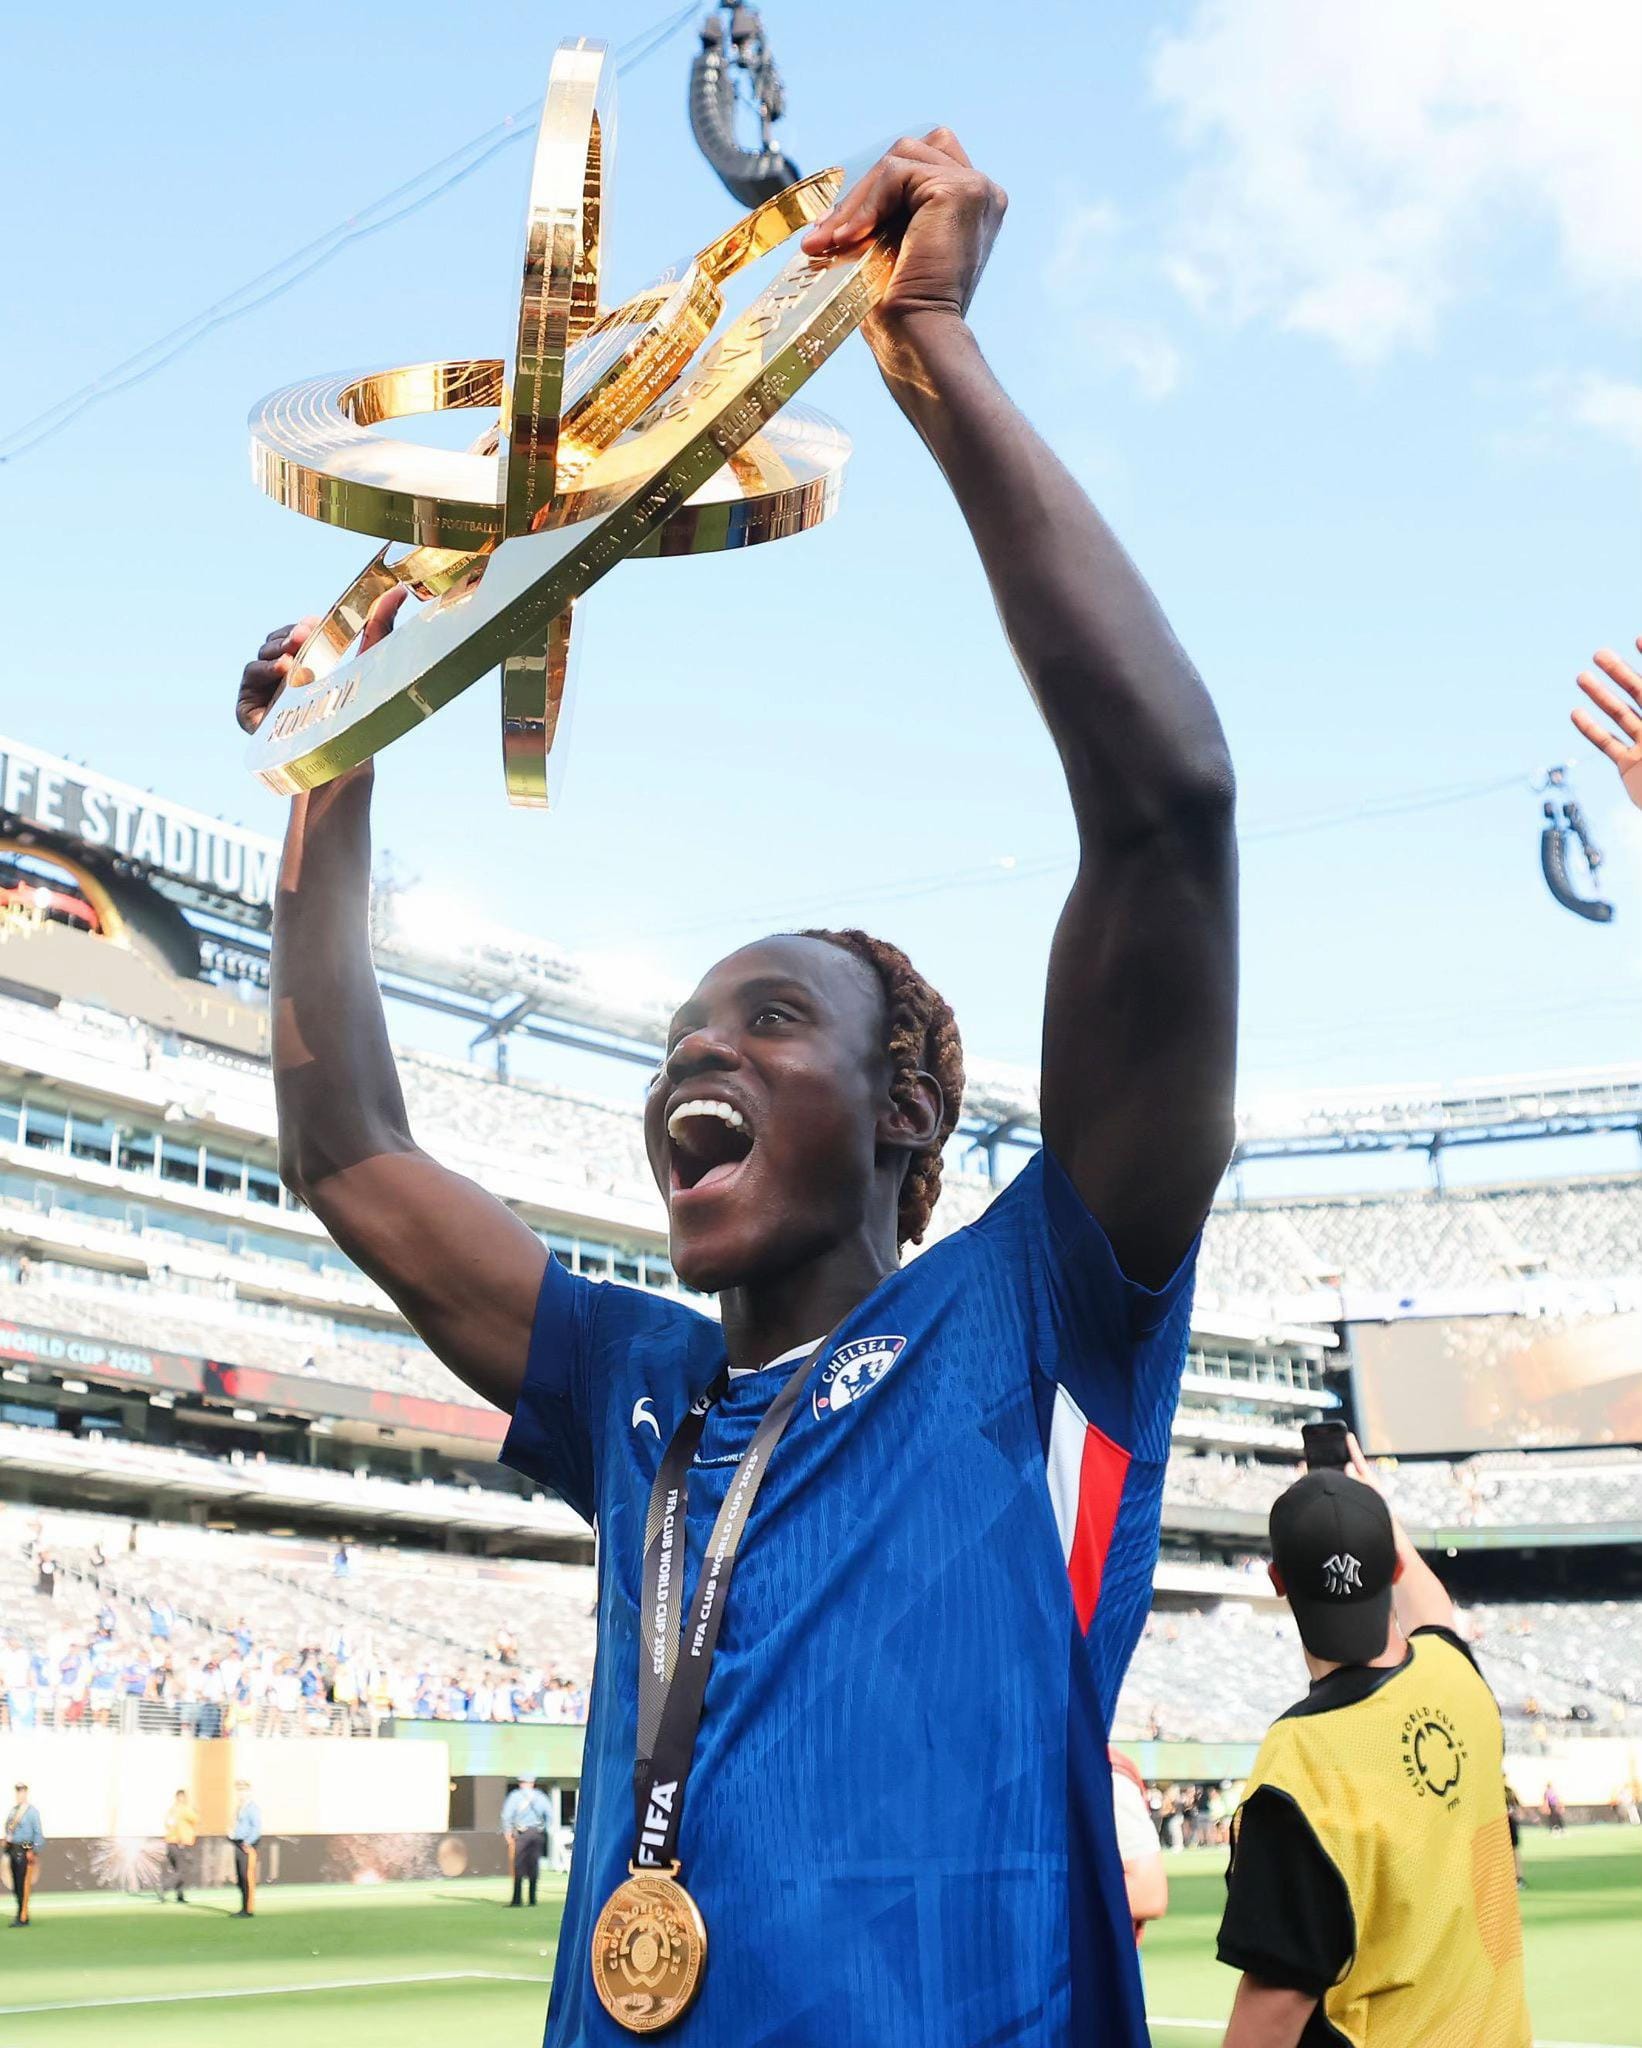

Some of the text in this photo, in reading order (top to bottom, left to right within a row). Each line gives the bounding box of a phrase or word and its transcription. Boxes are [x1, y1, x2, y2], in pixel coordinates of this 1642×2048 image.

[79, 785, 280, 907] STADIUM
[67, 1341, 107, 1365] CUP
[822, 1340, 887, 1384] CHELSEA
[665, 1488, 678, 1515] FIFA
[661, 1515, 674, 1549] CLUB
[657, 1550, 672, 1601] WORLD
[690, 1622, 707, 1656] FIFA
[700, 1579, 717, 1620] CLUB
[710, 1522, 732, 1577] WORLD
[728, 1491, 743, 1520] CUP
[1322, 1552, 1363, 1595] NY
[655, 1603, 667, 1633] CUP
[1401, 1706, 1430, 1744] WORLD
[1403, 1754, 1425, 1797] CLUB
[638, 1780, 678, 1867] FIFA
